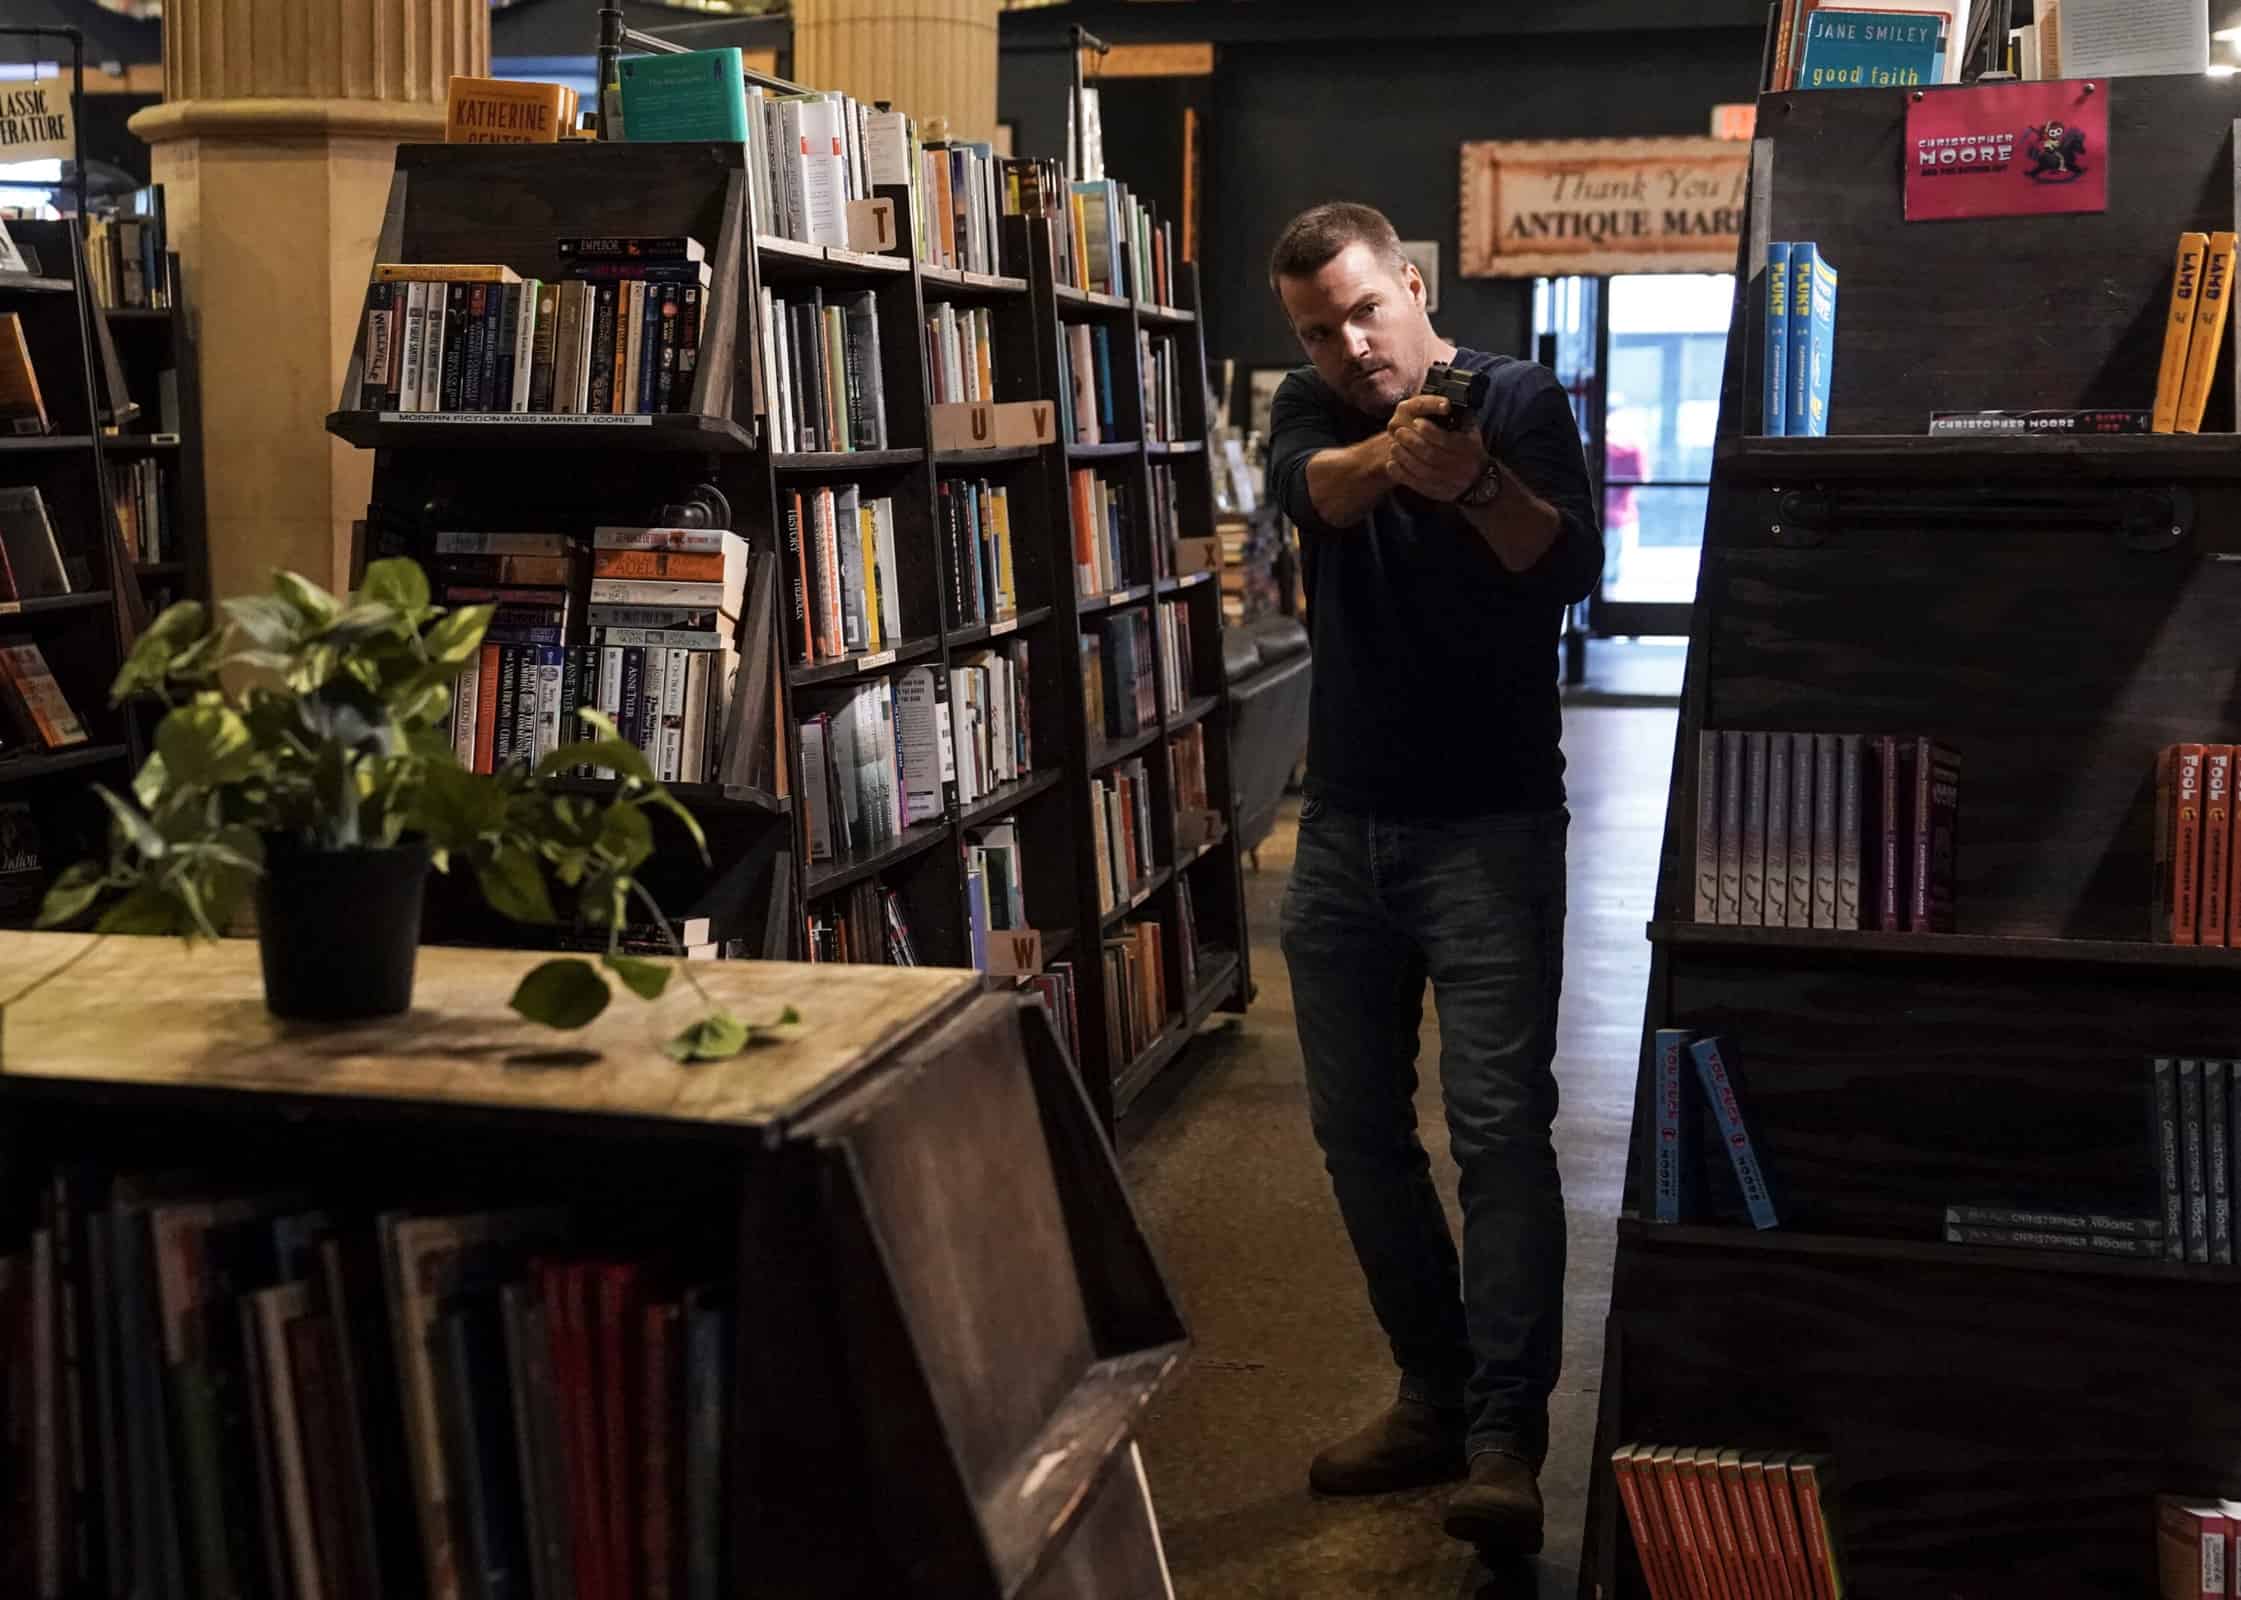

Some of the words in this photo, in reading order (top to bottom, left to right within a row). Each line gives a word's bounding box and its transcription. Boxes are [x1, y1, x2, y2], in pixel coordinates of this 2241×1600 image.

[1814, 23, 1856, 41] JANE
[1864, 24, 1928, 44] SMILEY
[1812, 65, 1864, 87] good
[1871, 65, 1919, 87] faith
[456, 99, 550, 131] KATHERINE
[1918, 134, 2014, 148] CHRISTOPHER
[1919, 145, 2013, 165] MOORE
[1545, 168, 1648, 203] Thank
[1656, 168, 1720, 200] You
[873, 206, 889, 244] T
[1508, 209, 1649, 244] ANTIQUE
[1770, 262, 1786, 316] FLUKE
[1795, 262, 1811, 316] FLUKE
[2177, 251, 2199, 301] LAMB
[2205, 252, 2229, 302] LAMB
[370, 312, 388, 384] WELLVILLE
[971, 407, 987, 441] U
[1032, 407, 1047, 439] V
[1937, 419, 2025, 429] CHRISTOPHER
[2029, 418, 2076, 429] MOORE
[786, 509, 802, 555] HISTORY
[1204, 543, 1216, 567] X
[566, 662, 577, 687] ANNE
[627, 666, 640, 692] ANNE
[562, 688, 575, 713] TYLER
[624, 692, 637, 718] TYLER
[650, 695, 659, 714] The
[2182, 755, 2199, 801] FOOL
[2209, 755, 2228, 801] FOOL
[1012, 937, 1035, 969] W
[1667, 1045, 1679, 1075] YOU
[1709, 1053, 1726, 1082] YOU
[1666, 1080, 1680, 1121] SUCK
[1659, 1149, 1670, 1197] MOORE
[1736, 1156, 1759, 1201] MOORE
